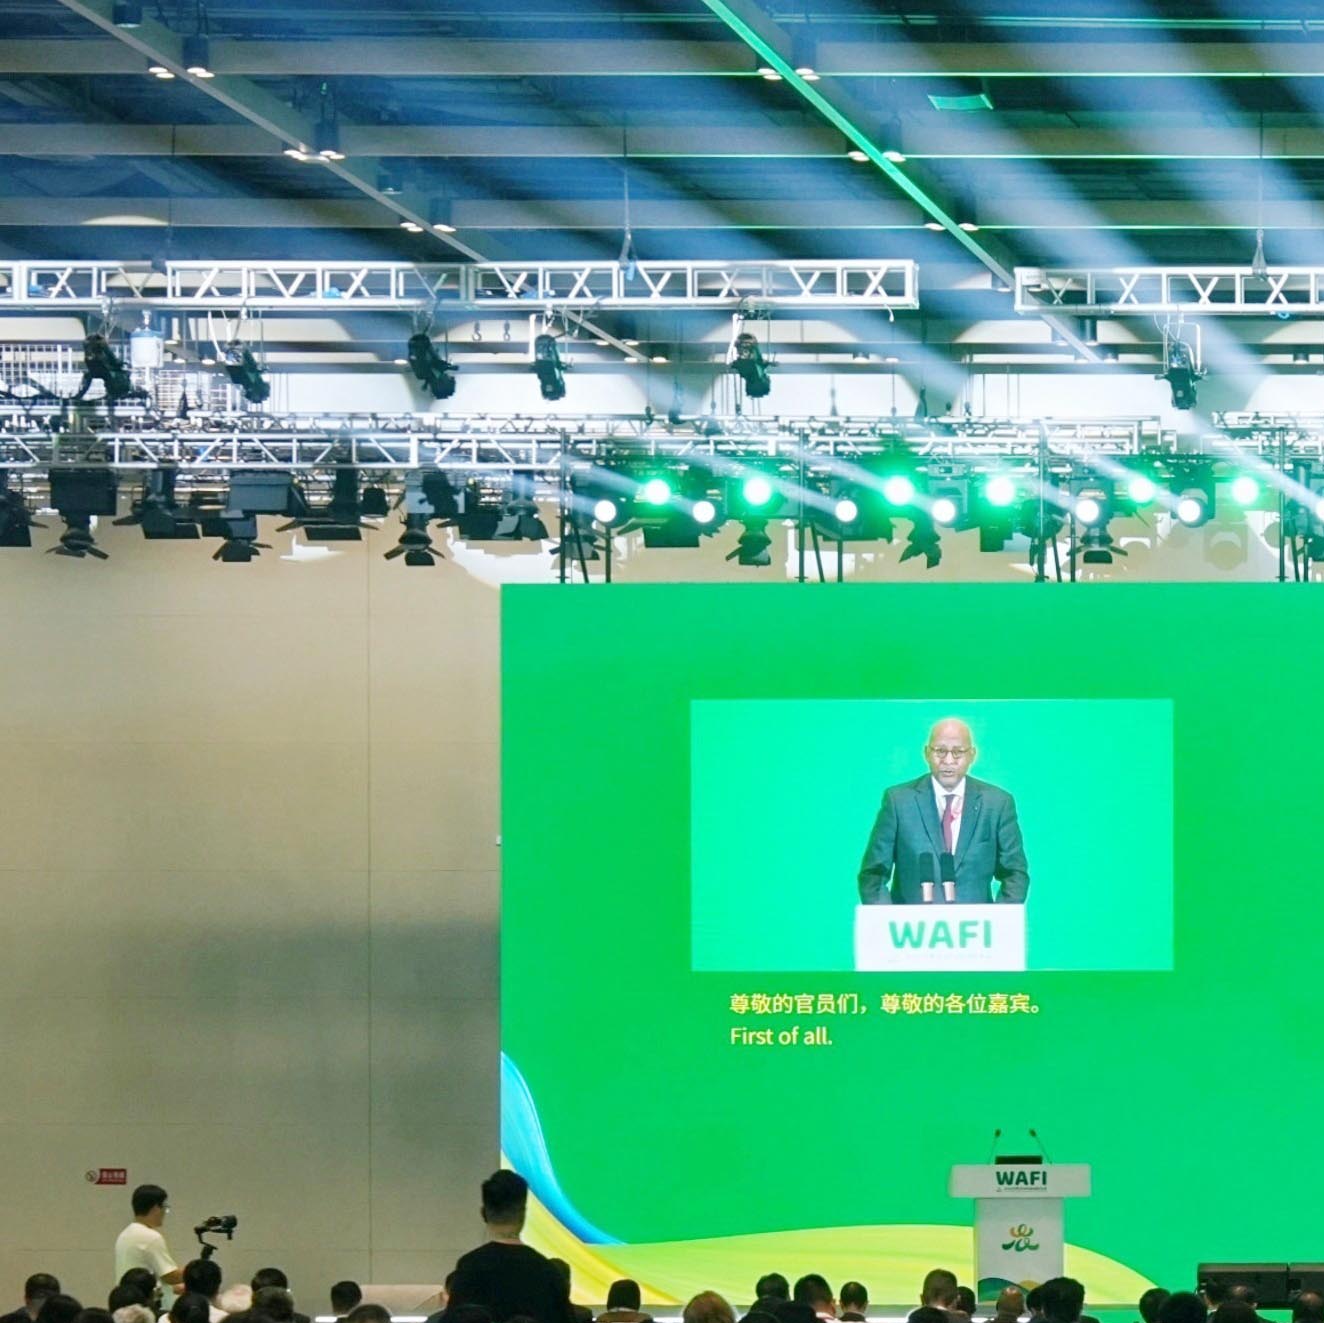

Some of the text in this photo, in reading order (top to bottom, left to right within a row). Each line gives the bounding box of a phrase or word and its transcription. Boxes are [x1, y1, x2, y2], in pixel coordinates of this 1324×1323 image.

[888, 919, 992, 949] WAFI
[730, 1025, 833, 1046] First of all.
[995, 1170, 1048, 1186] WAFI
